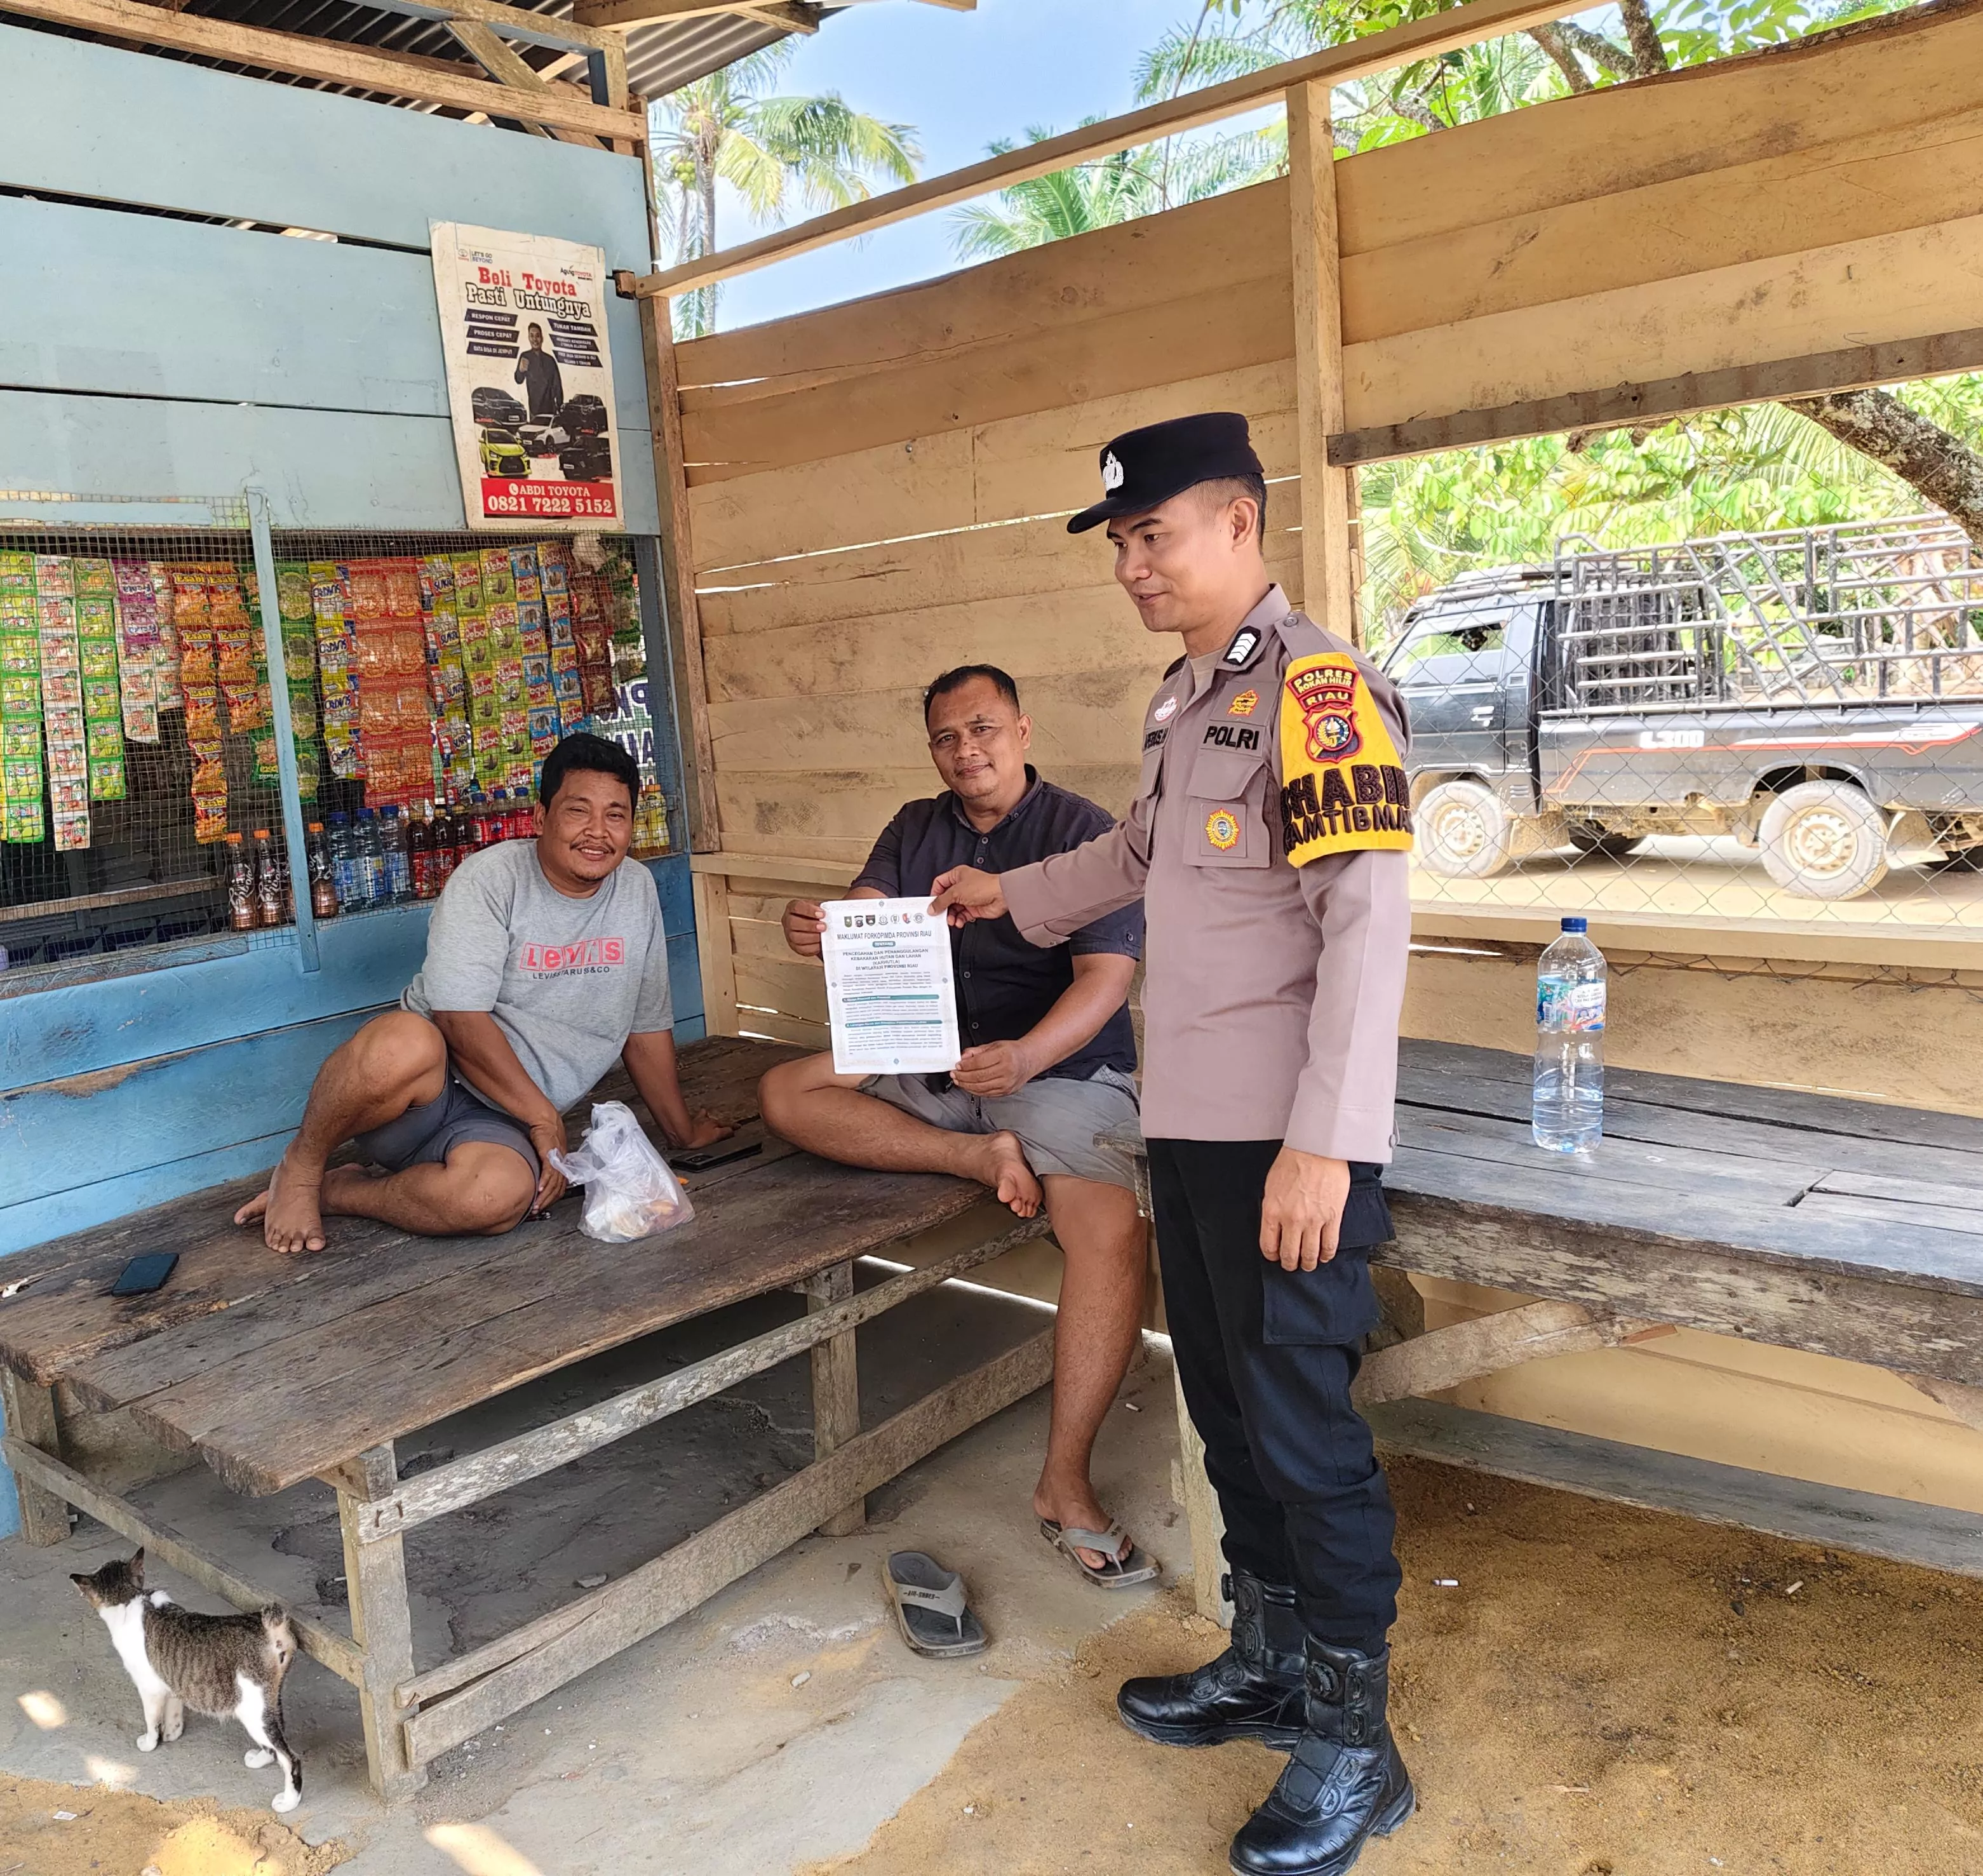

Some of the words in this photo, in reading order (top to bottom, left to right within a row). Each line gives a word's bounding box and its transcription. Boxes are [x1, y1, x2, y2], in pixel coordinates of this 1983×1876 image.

[478, 266, 513, 288] Beli
[522, 272, 577, 297] Toyota
[466, 282, 507, 307] Pasti
[513, 288, 591, 320] Untungnya
[473, 329, 495, 337] PROSES
[520, 484, 546, 496] ABDI
[548, 486, 591, 497] TOYOTA
[487, 495, 527, 511] 0821
[532, 498, 571, 513] 7222
[575, 498, 613, 513] 5152
[175, 574, 205, 584] Esabi
[208, 575, 238, 584] Esabi
[184, 632, 212, 641] Esabi
[221, 632, 250, 641] Esabi
[1294, 669, 1352, 688] POLRES
[1298, 678, 1328, 693] ROKAN
[191, 688, 217, 698] Esabi
[1305, 692, 1348, 706] RIAU
[1203, 726, 1261, 751] POLRI
[1639, 730, 1705, 749] L300
[199, 796, 227, 808] Esabi
[837, 932, 864, 941] MAKLUMAT
[896, 930, 919, 939] PROVINSI
